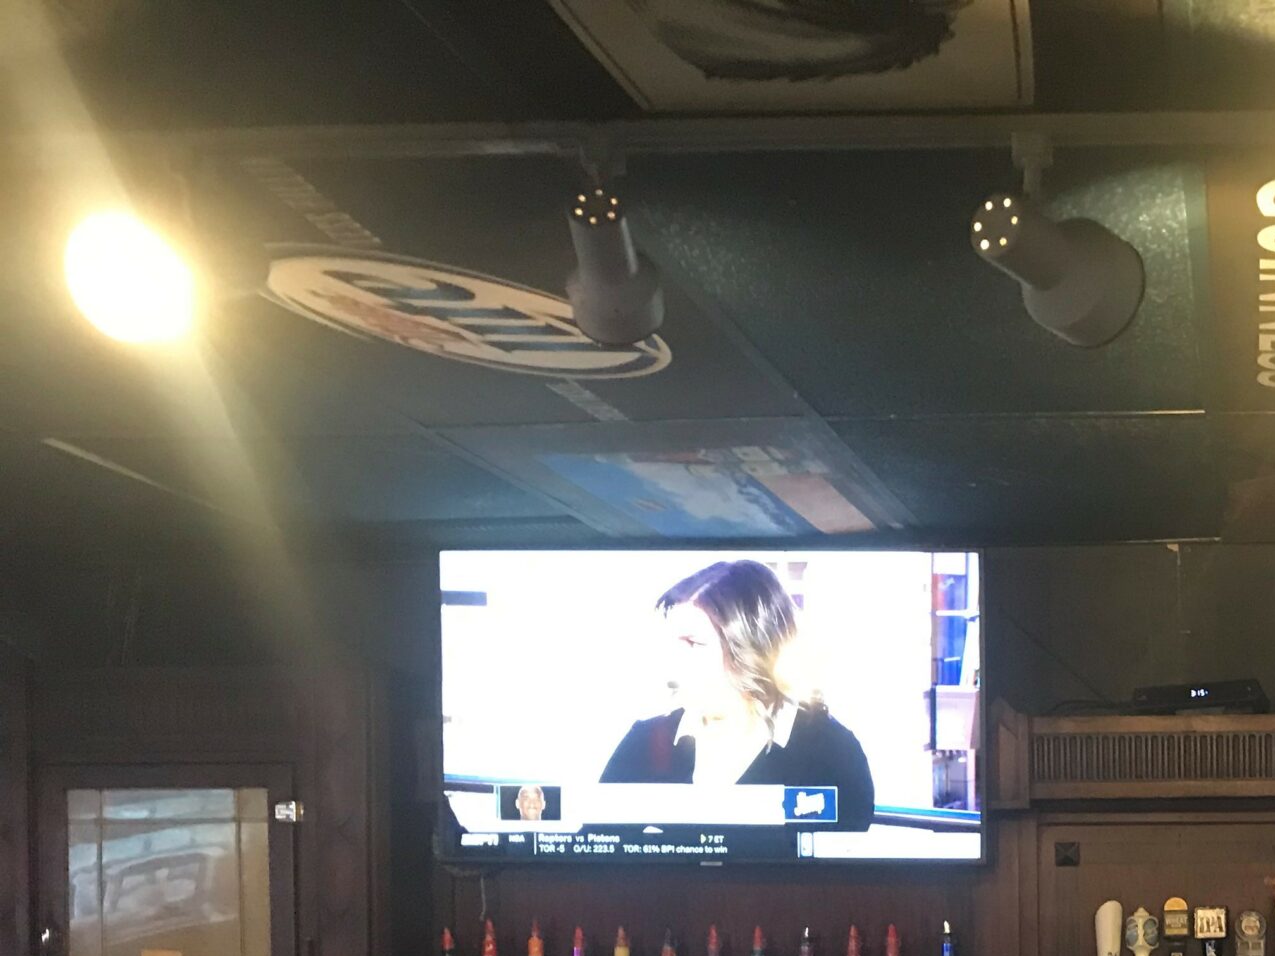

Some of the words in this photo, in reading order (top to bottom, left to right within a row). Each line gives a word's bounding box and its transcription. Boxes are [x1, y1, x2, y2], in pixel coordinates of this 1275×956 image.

[538, 834, 572, 844] Raptors
[587, 834, 620, 843] Pistons
[539, 845, 554, 853] TOR
[713, 845, 728, 854] win
[1199, 913, 1225, 935] IPA
